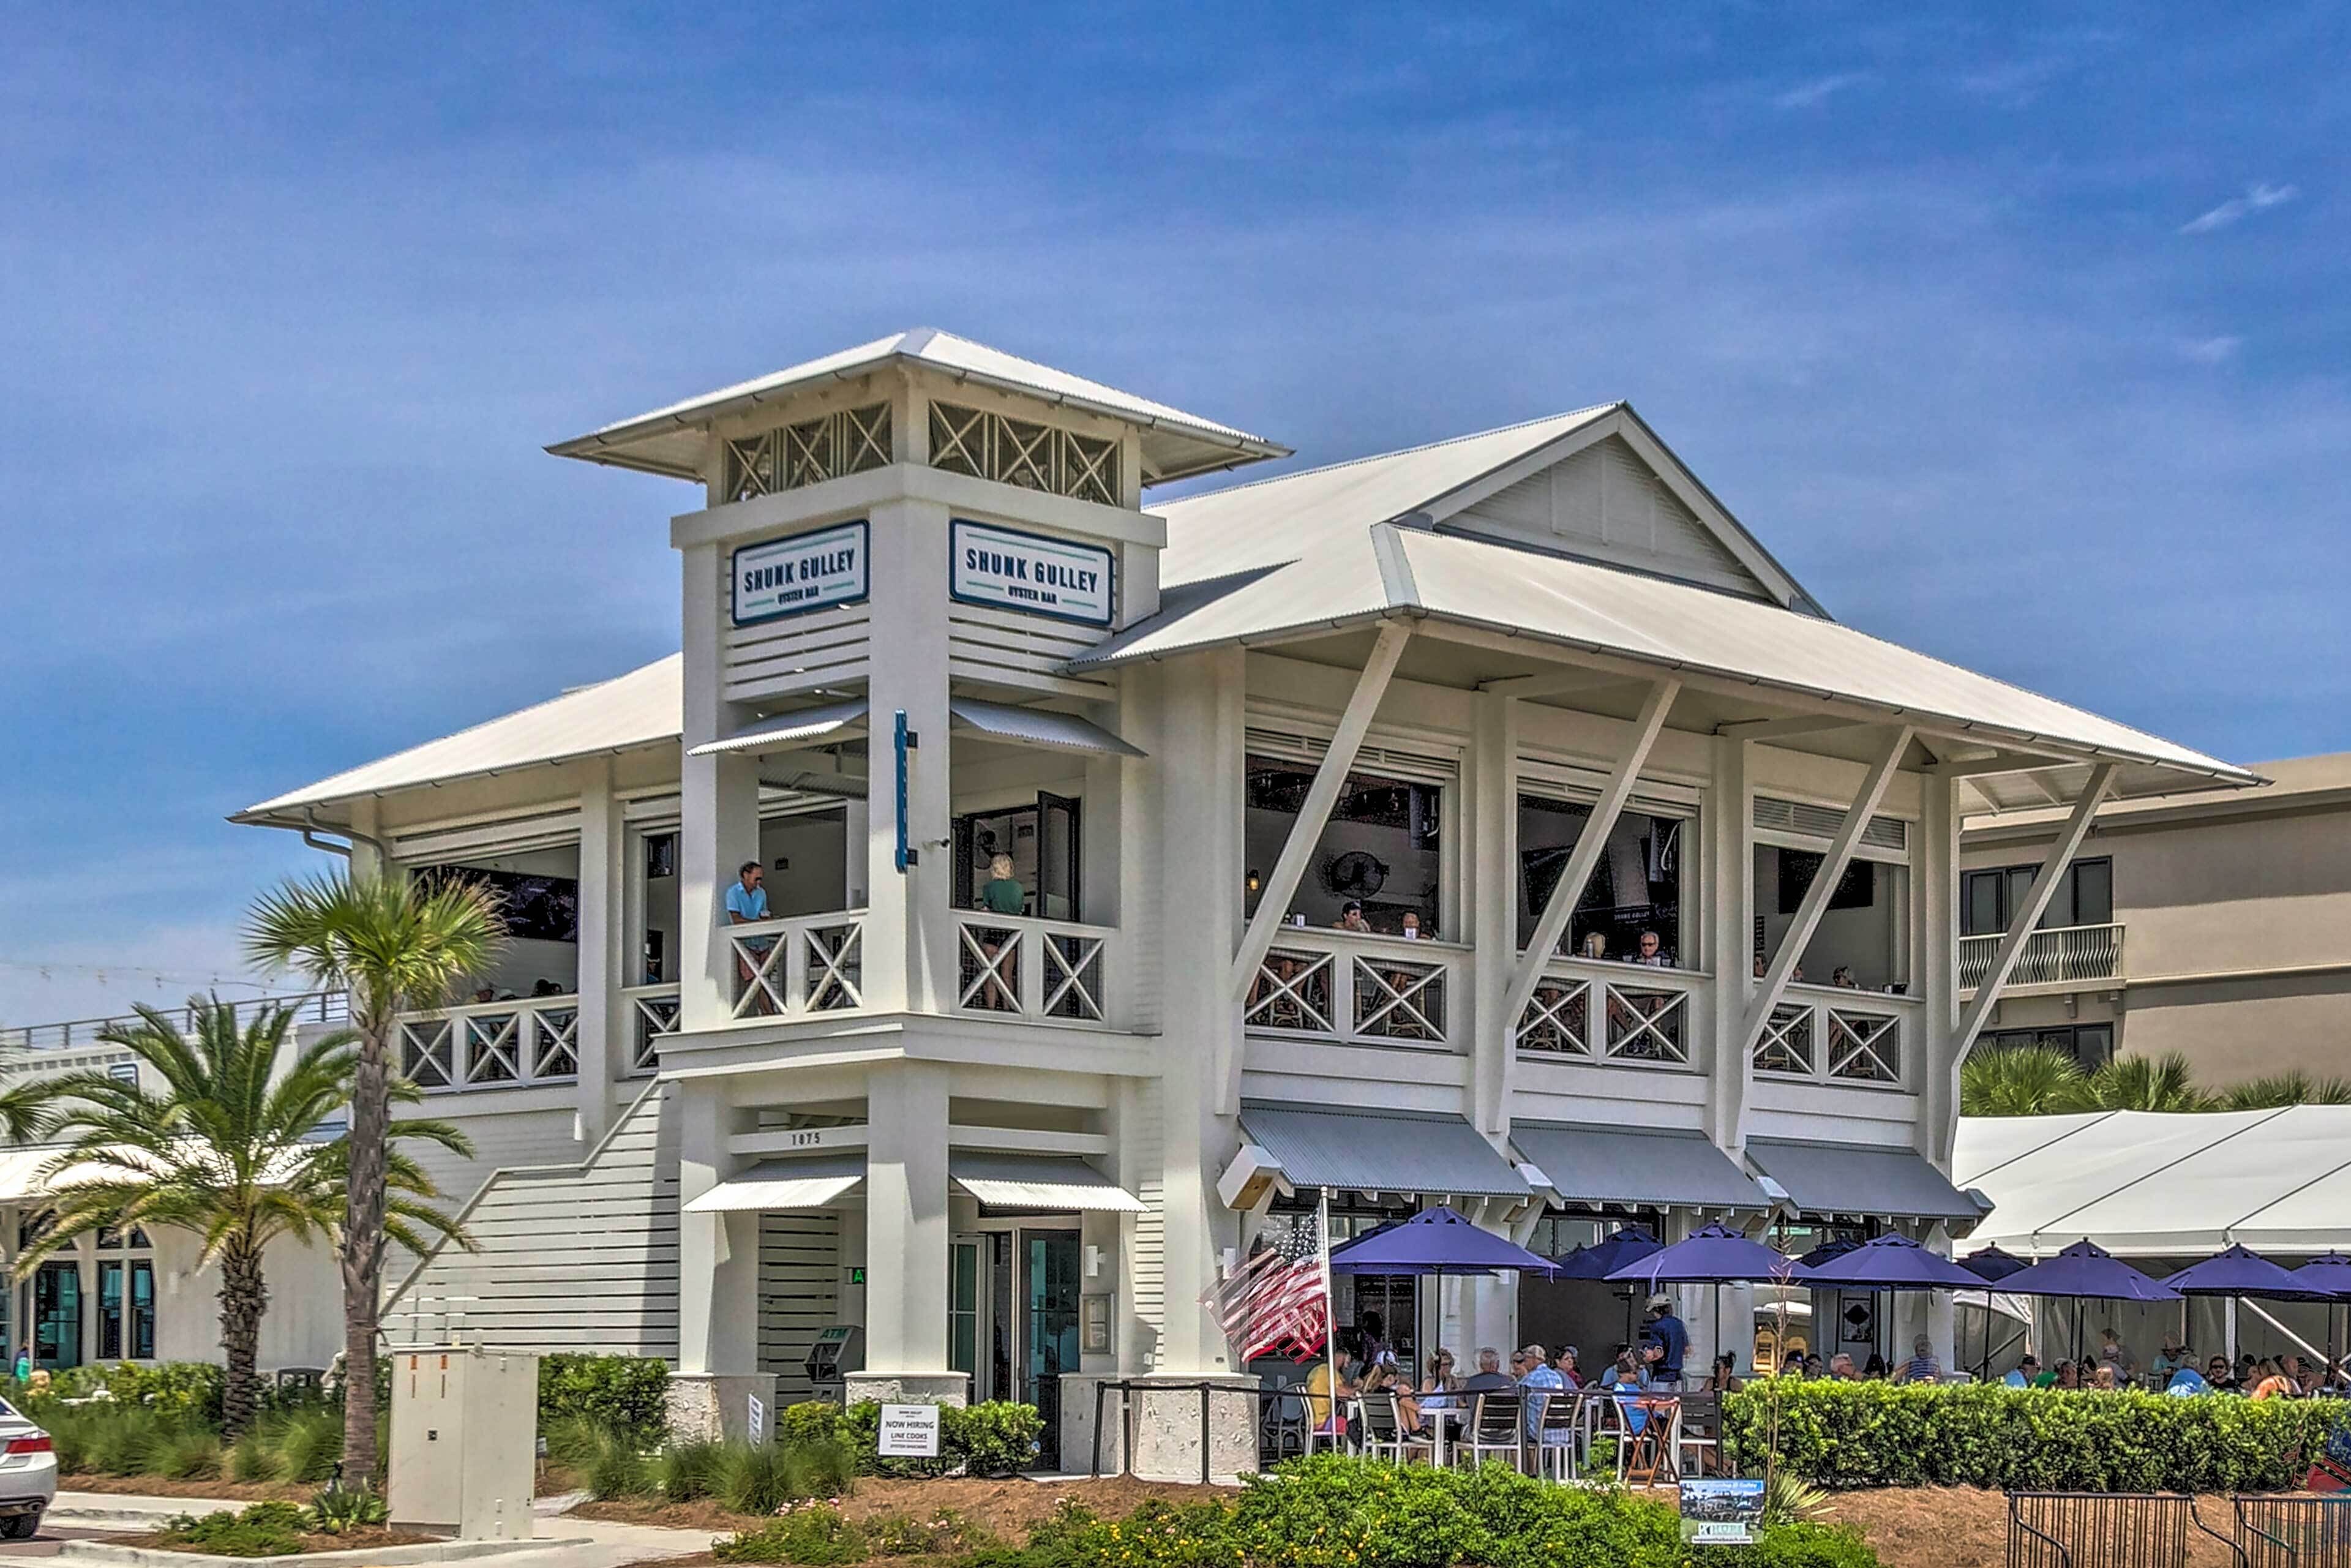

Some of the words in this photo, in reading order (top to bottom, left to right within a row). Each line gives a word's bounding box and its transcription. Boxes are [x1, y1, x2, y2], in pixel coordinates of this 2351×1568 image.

[744, 561, 794, 593] SHUNK
[800, 549, 855, 580] GULLEY
[966, 548, 1027, 580] SHUNK
[1034, 561, 1098, 593] GULLEY
[778, 588, 804, 605] OYSTER
[805, 585, 820, 598] BAR
[1007, 585, 1038, 602] OYSTER
[1041, 591, 1058, 605] BAR
[792, 1133, 820, 1146] 1875
[820, 1327, 849, 1339] ATM
[906, 1421, 935, 1430] HIRING
